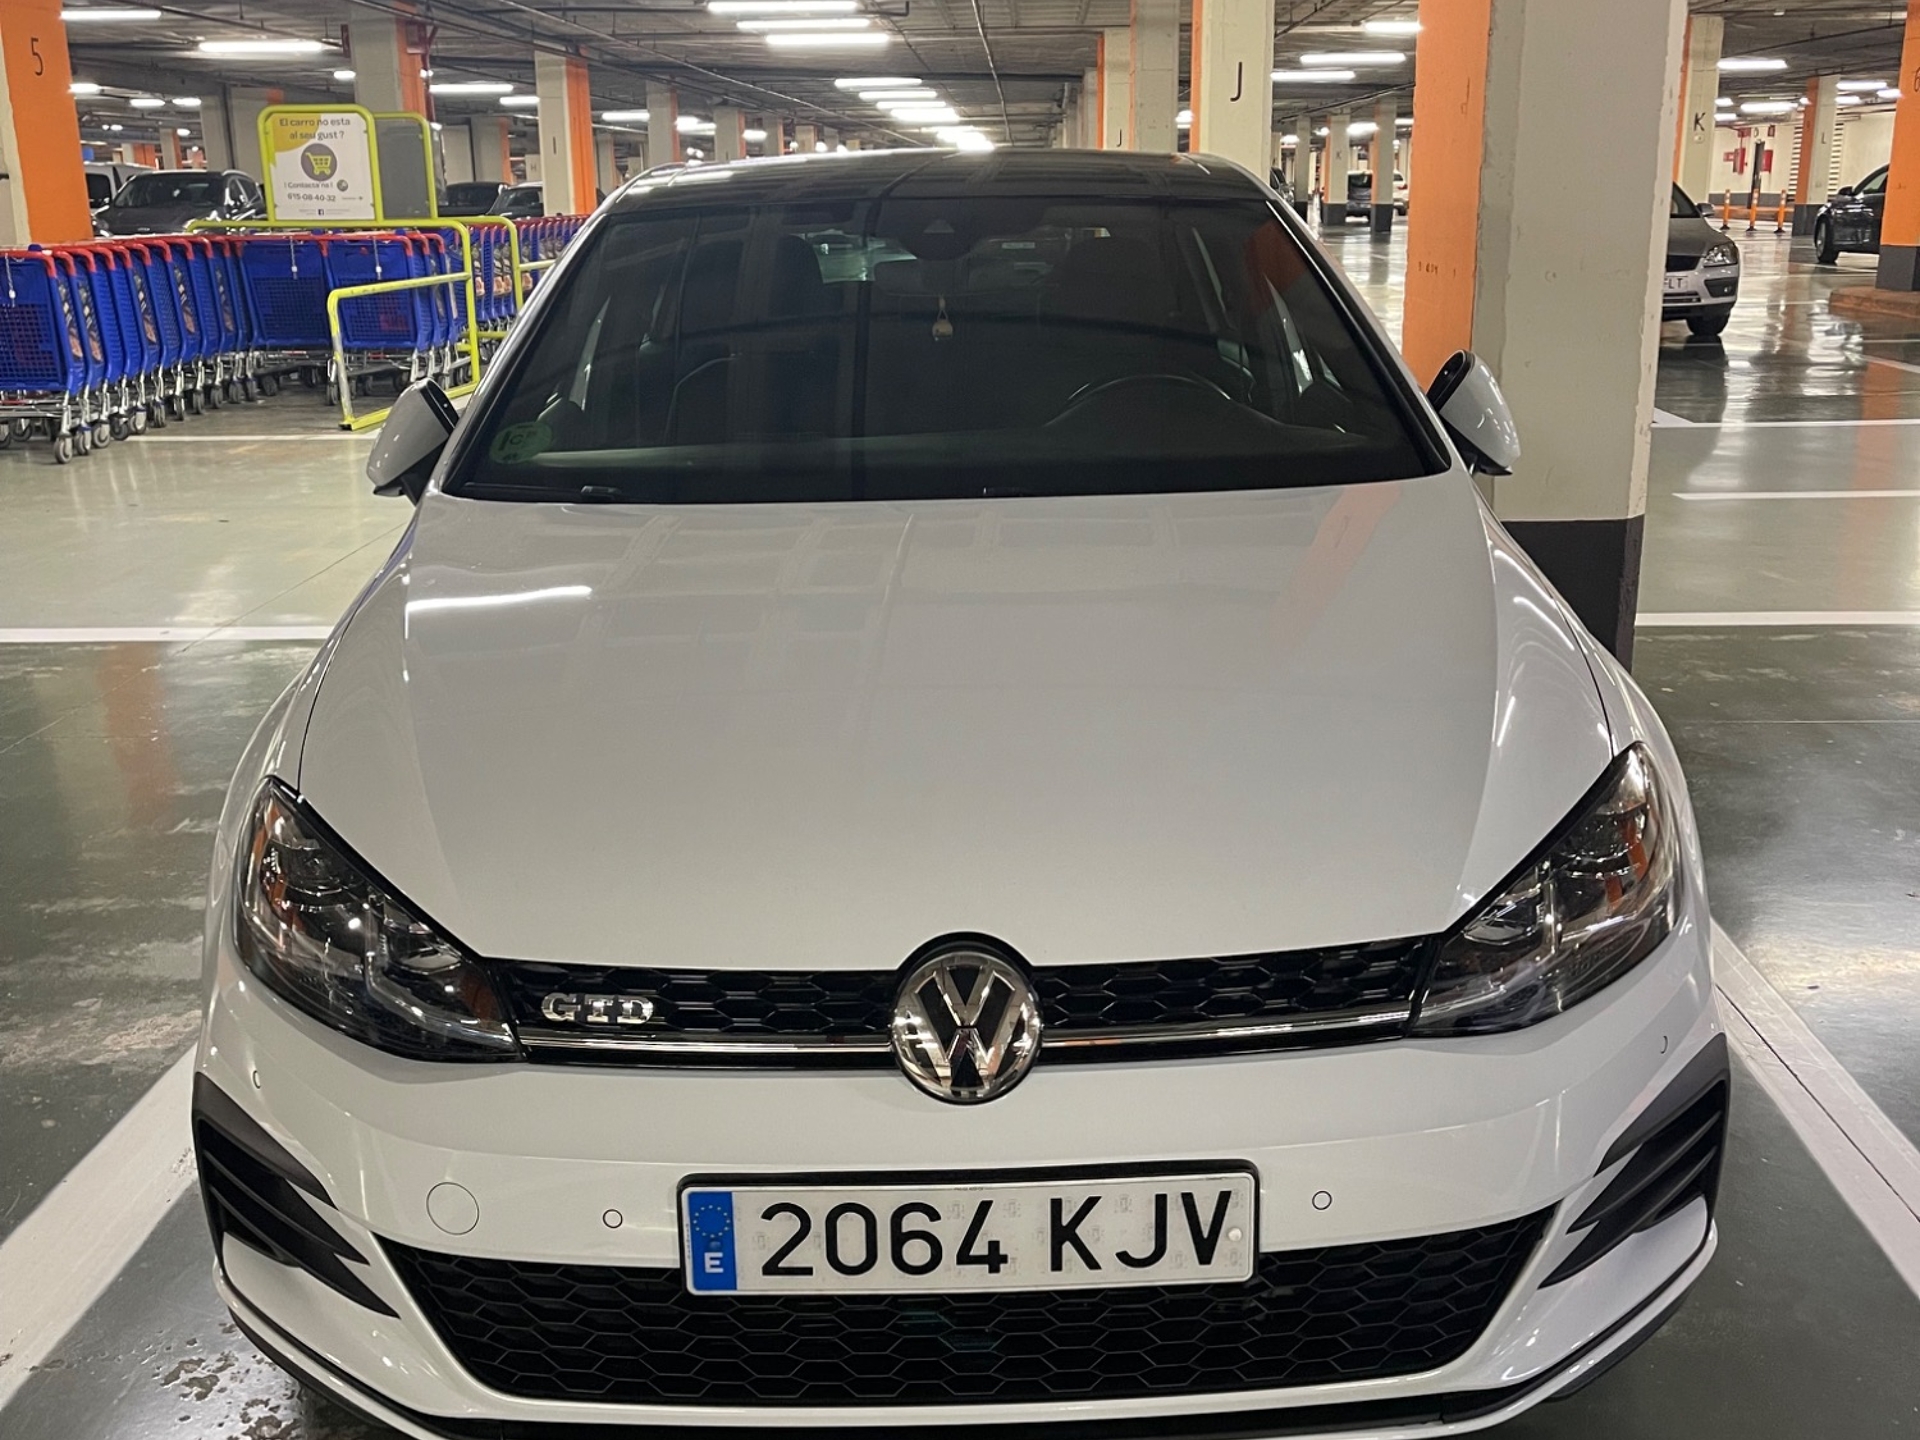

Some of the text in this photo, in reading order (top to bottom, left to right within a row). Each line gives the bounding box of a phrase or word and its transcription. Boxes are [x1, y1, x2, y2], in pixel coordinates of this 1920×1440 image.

[31, 37, 44, 76] 5
[1230, 61, 1243, 102] J
[279, 118, 288, 126] El
[289, 131, 298, 139] al
[1693, 112, 1706, 132] K
[541, 992, 654, 1024] GTD
[760, 1199, 1009, 1277] 2064
[1048, 1189, 1232, 1273] KJV
[704, 1252, 724, 1273] E
